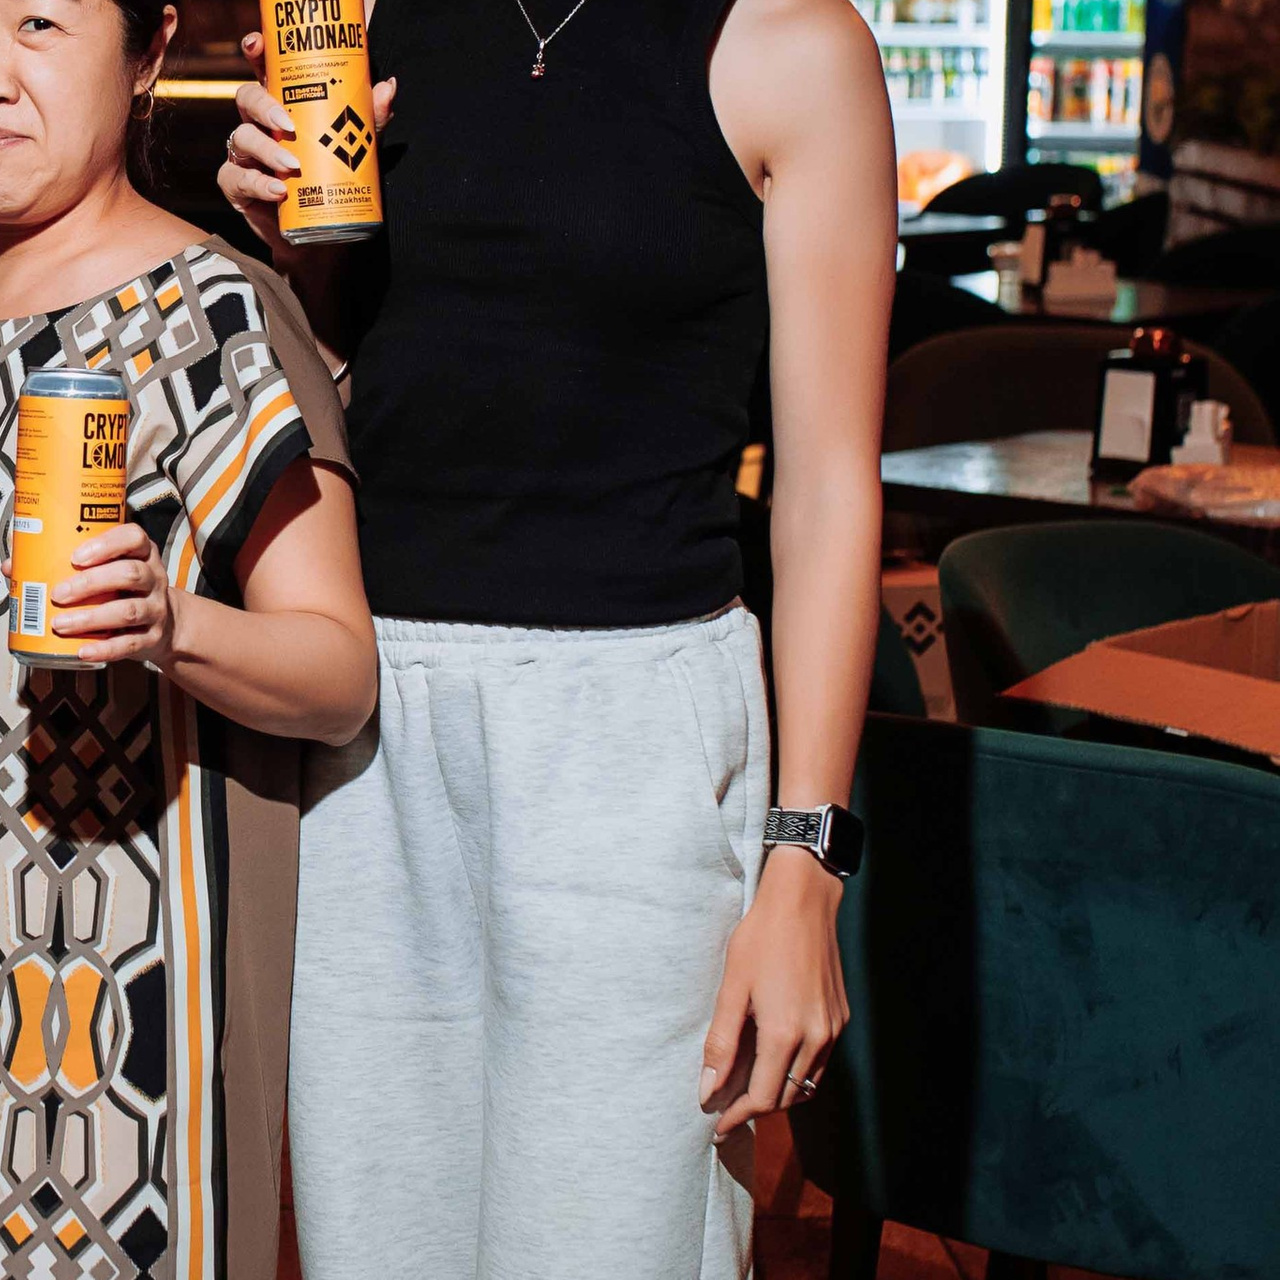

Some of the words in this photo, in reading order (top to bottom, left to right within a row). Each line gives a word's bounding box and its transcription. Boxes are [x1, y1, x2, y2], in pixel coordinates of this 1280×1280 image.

[297, 185, 324, 197] SIGMA
[327, 186, 372, 197] BINANCE
[307, 196, 324, 204] BRAU
[328, 196, 372, 205] Kazakhstan
[83, 506, 97, 519] 0.1
